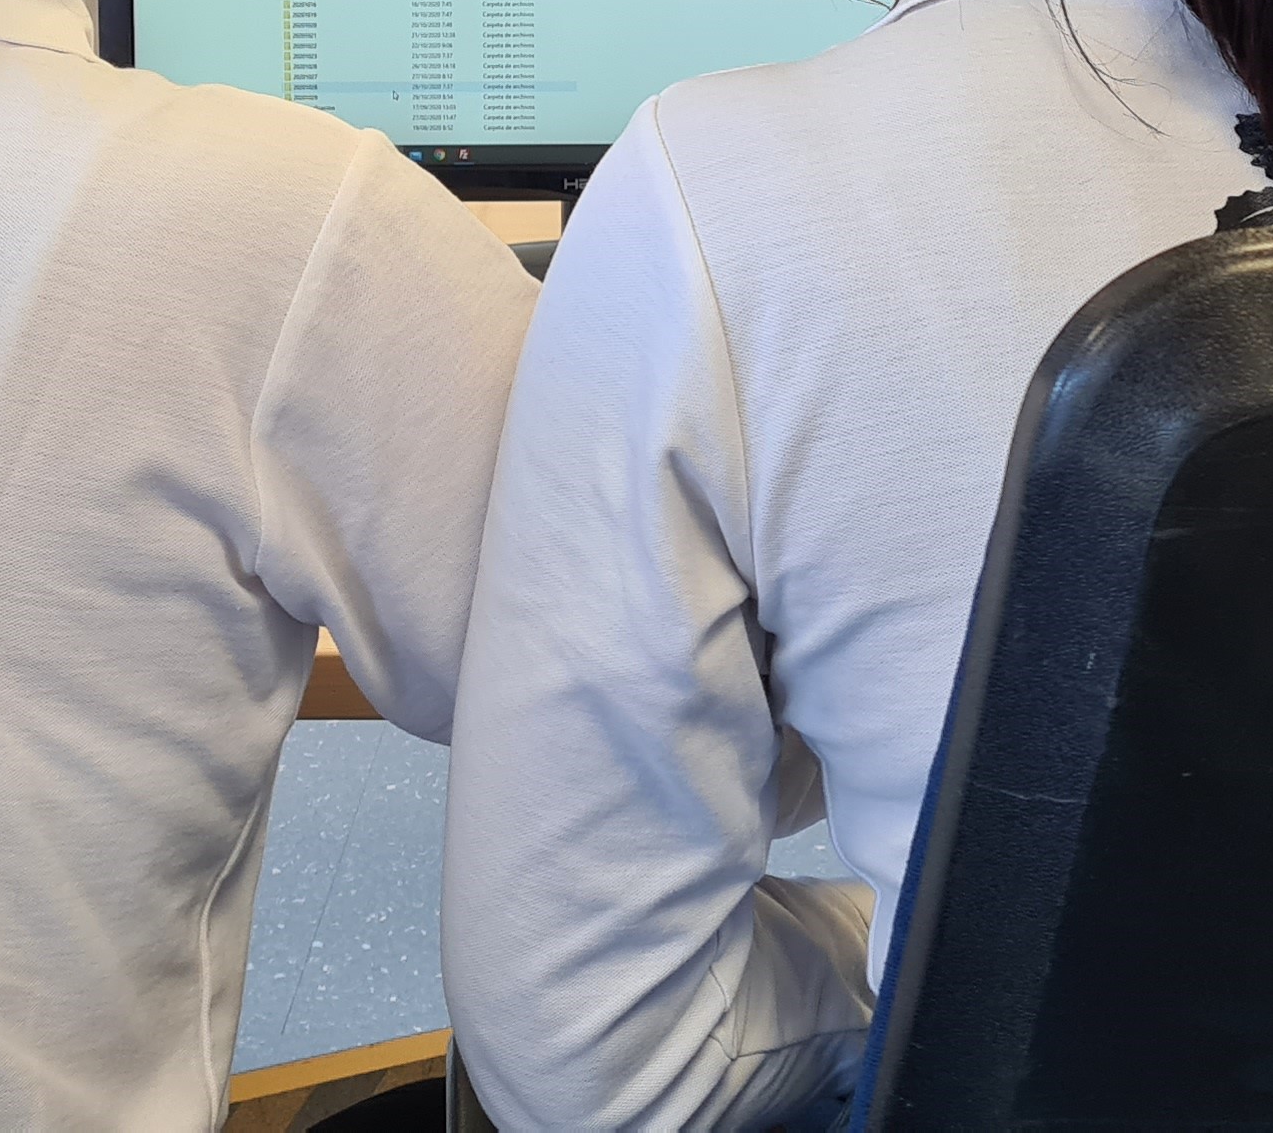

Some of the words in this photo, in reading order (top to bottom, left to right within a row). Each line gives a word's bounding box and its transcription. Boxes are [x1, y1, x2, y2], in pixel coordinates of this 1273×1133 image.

[482, 0, 503, 8] Carpeta
[482, 21, 503, 29] Carpeta
[482, 31, 503, 39] Carpeta
[482, 41, 503, 49] Carpeta
[483, 52, 503, 60] Carpeta
[483, 62, 503, 70] Carpeta
[483, 72, 503, 80] Carpeta
[483, 93, 504, 101] Carpeta
[483, 103, 504, 111] Carpeta
[483, 113, 504, 121] Carpeta
